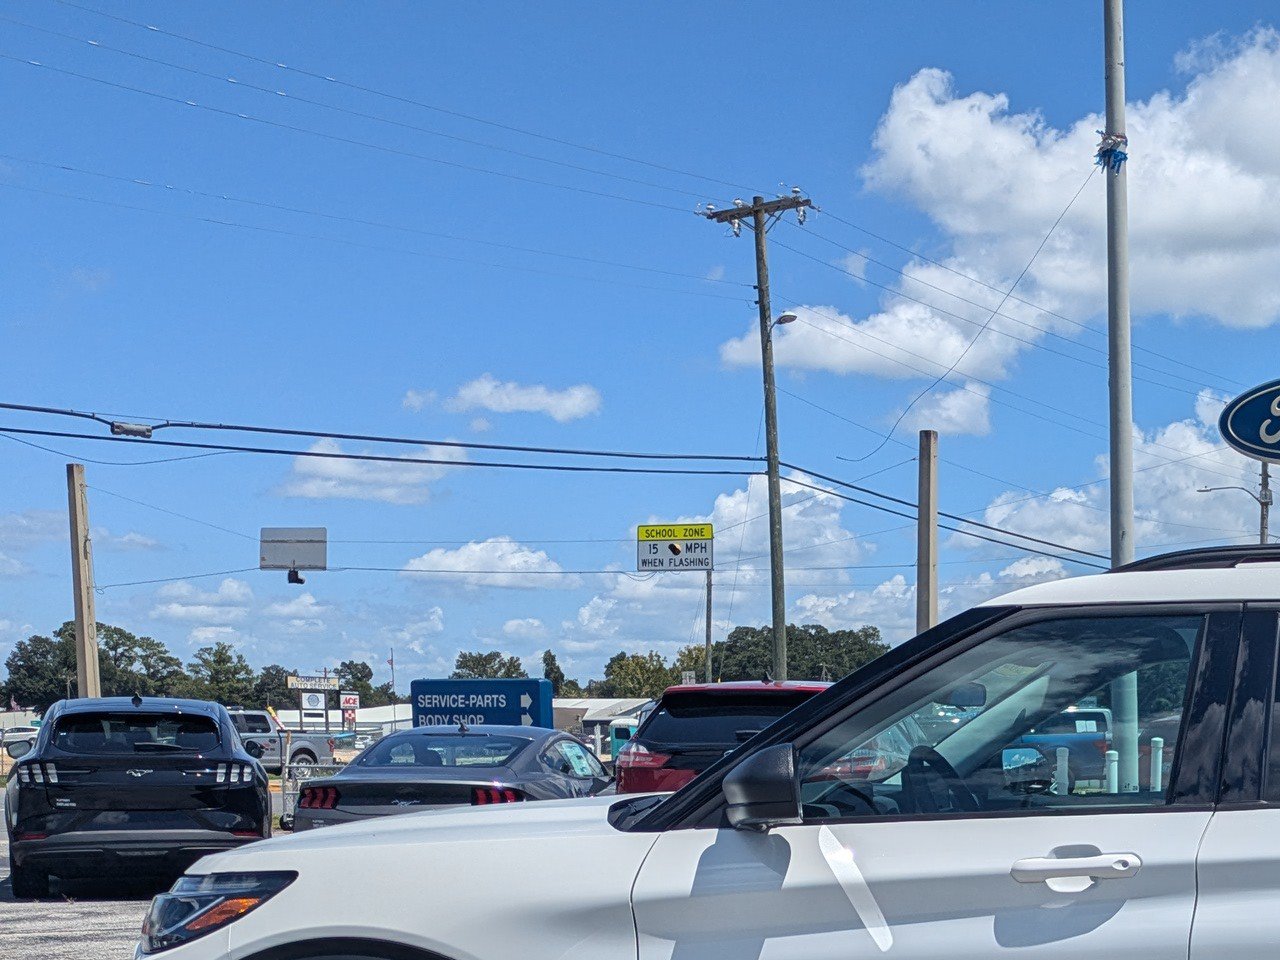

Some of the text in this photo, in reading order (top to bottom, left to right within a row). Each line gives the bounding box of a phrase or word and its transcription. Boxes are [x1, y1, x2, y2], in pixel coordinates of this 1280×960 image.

[645, 527, 706, 539] SCHOOL ZONE
[648, 542, 707, 555] 15 MPH
[641, 557, 710, 567] WHEN FLASHING
[343, 697, 358, 705] ACE
[417, 694, 507, 708] SERVICE-PARTS
[418, 714, 485, 726] BODY SHOP
